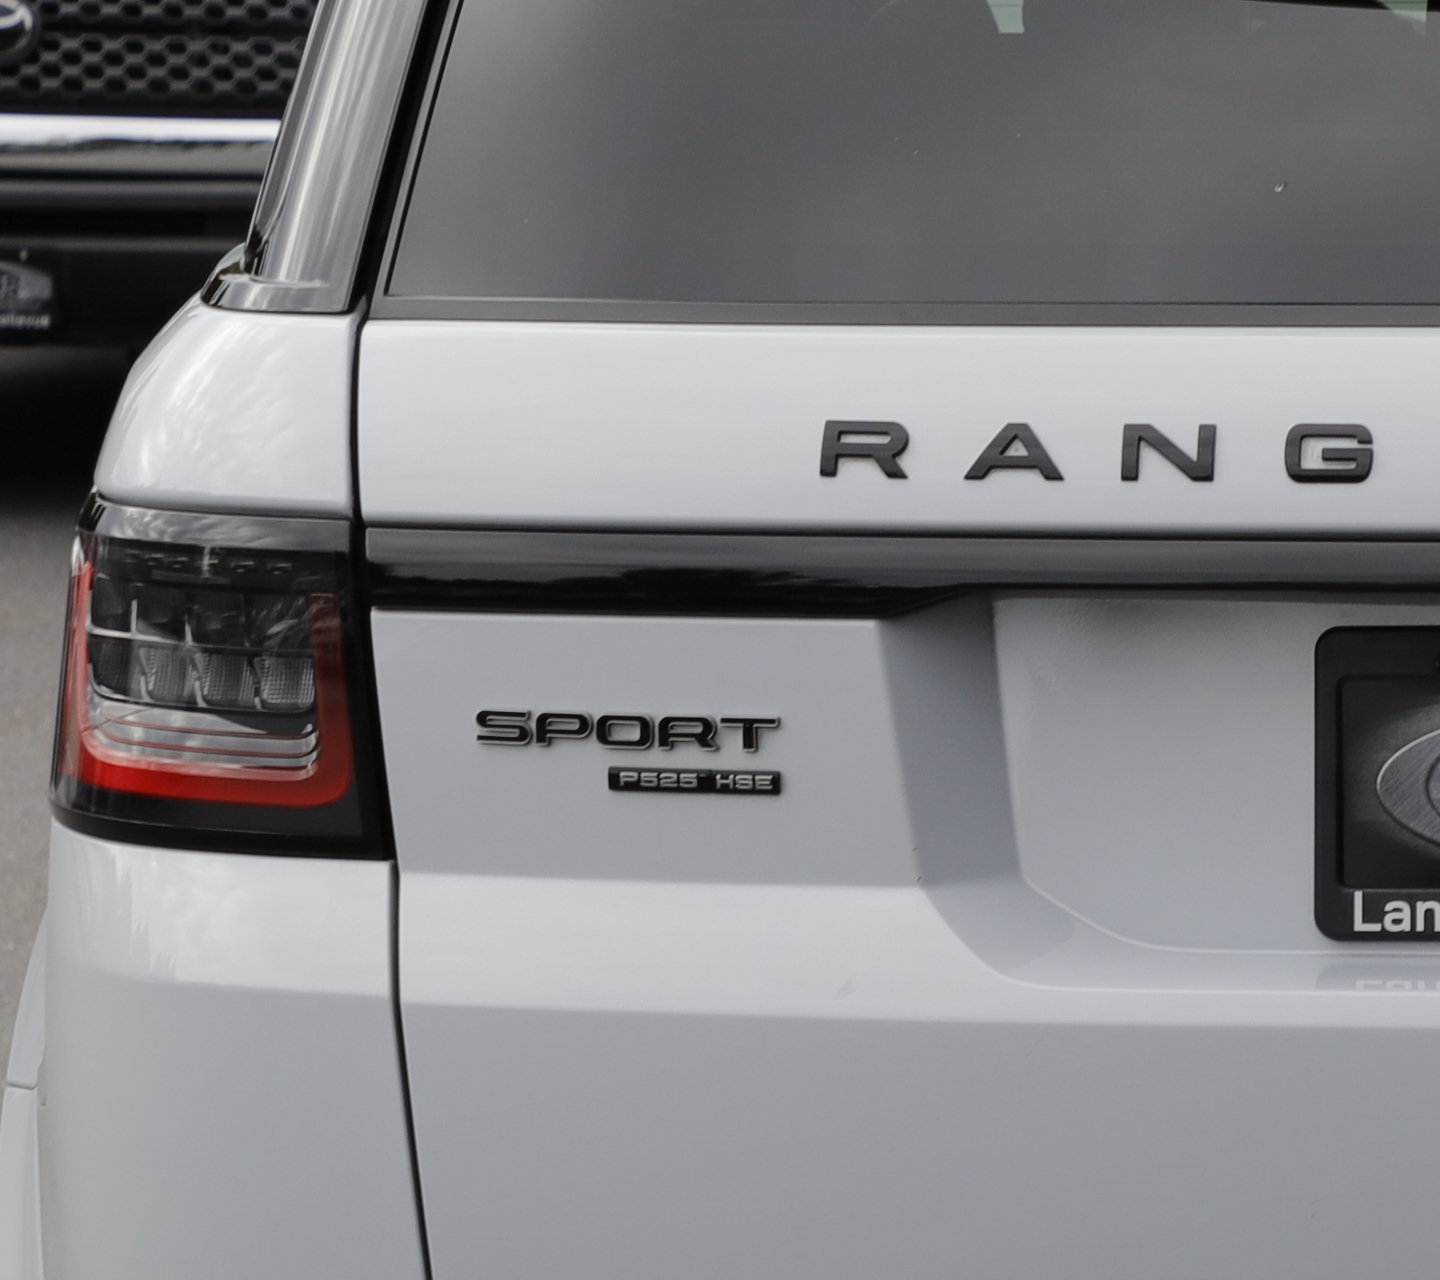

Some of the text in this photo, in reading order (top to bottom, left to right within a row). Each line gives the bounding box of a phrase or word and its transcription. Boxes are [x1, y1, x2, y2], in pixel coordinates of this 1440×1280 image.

[475, 709, 782, 754] SPORT
[618, 770, 774, 790] P525 HSE
